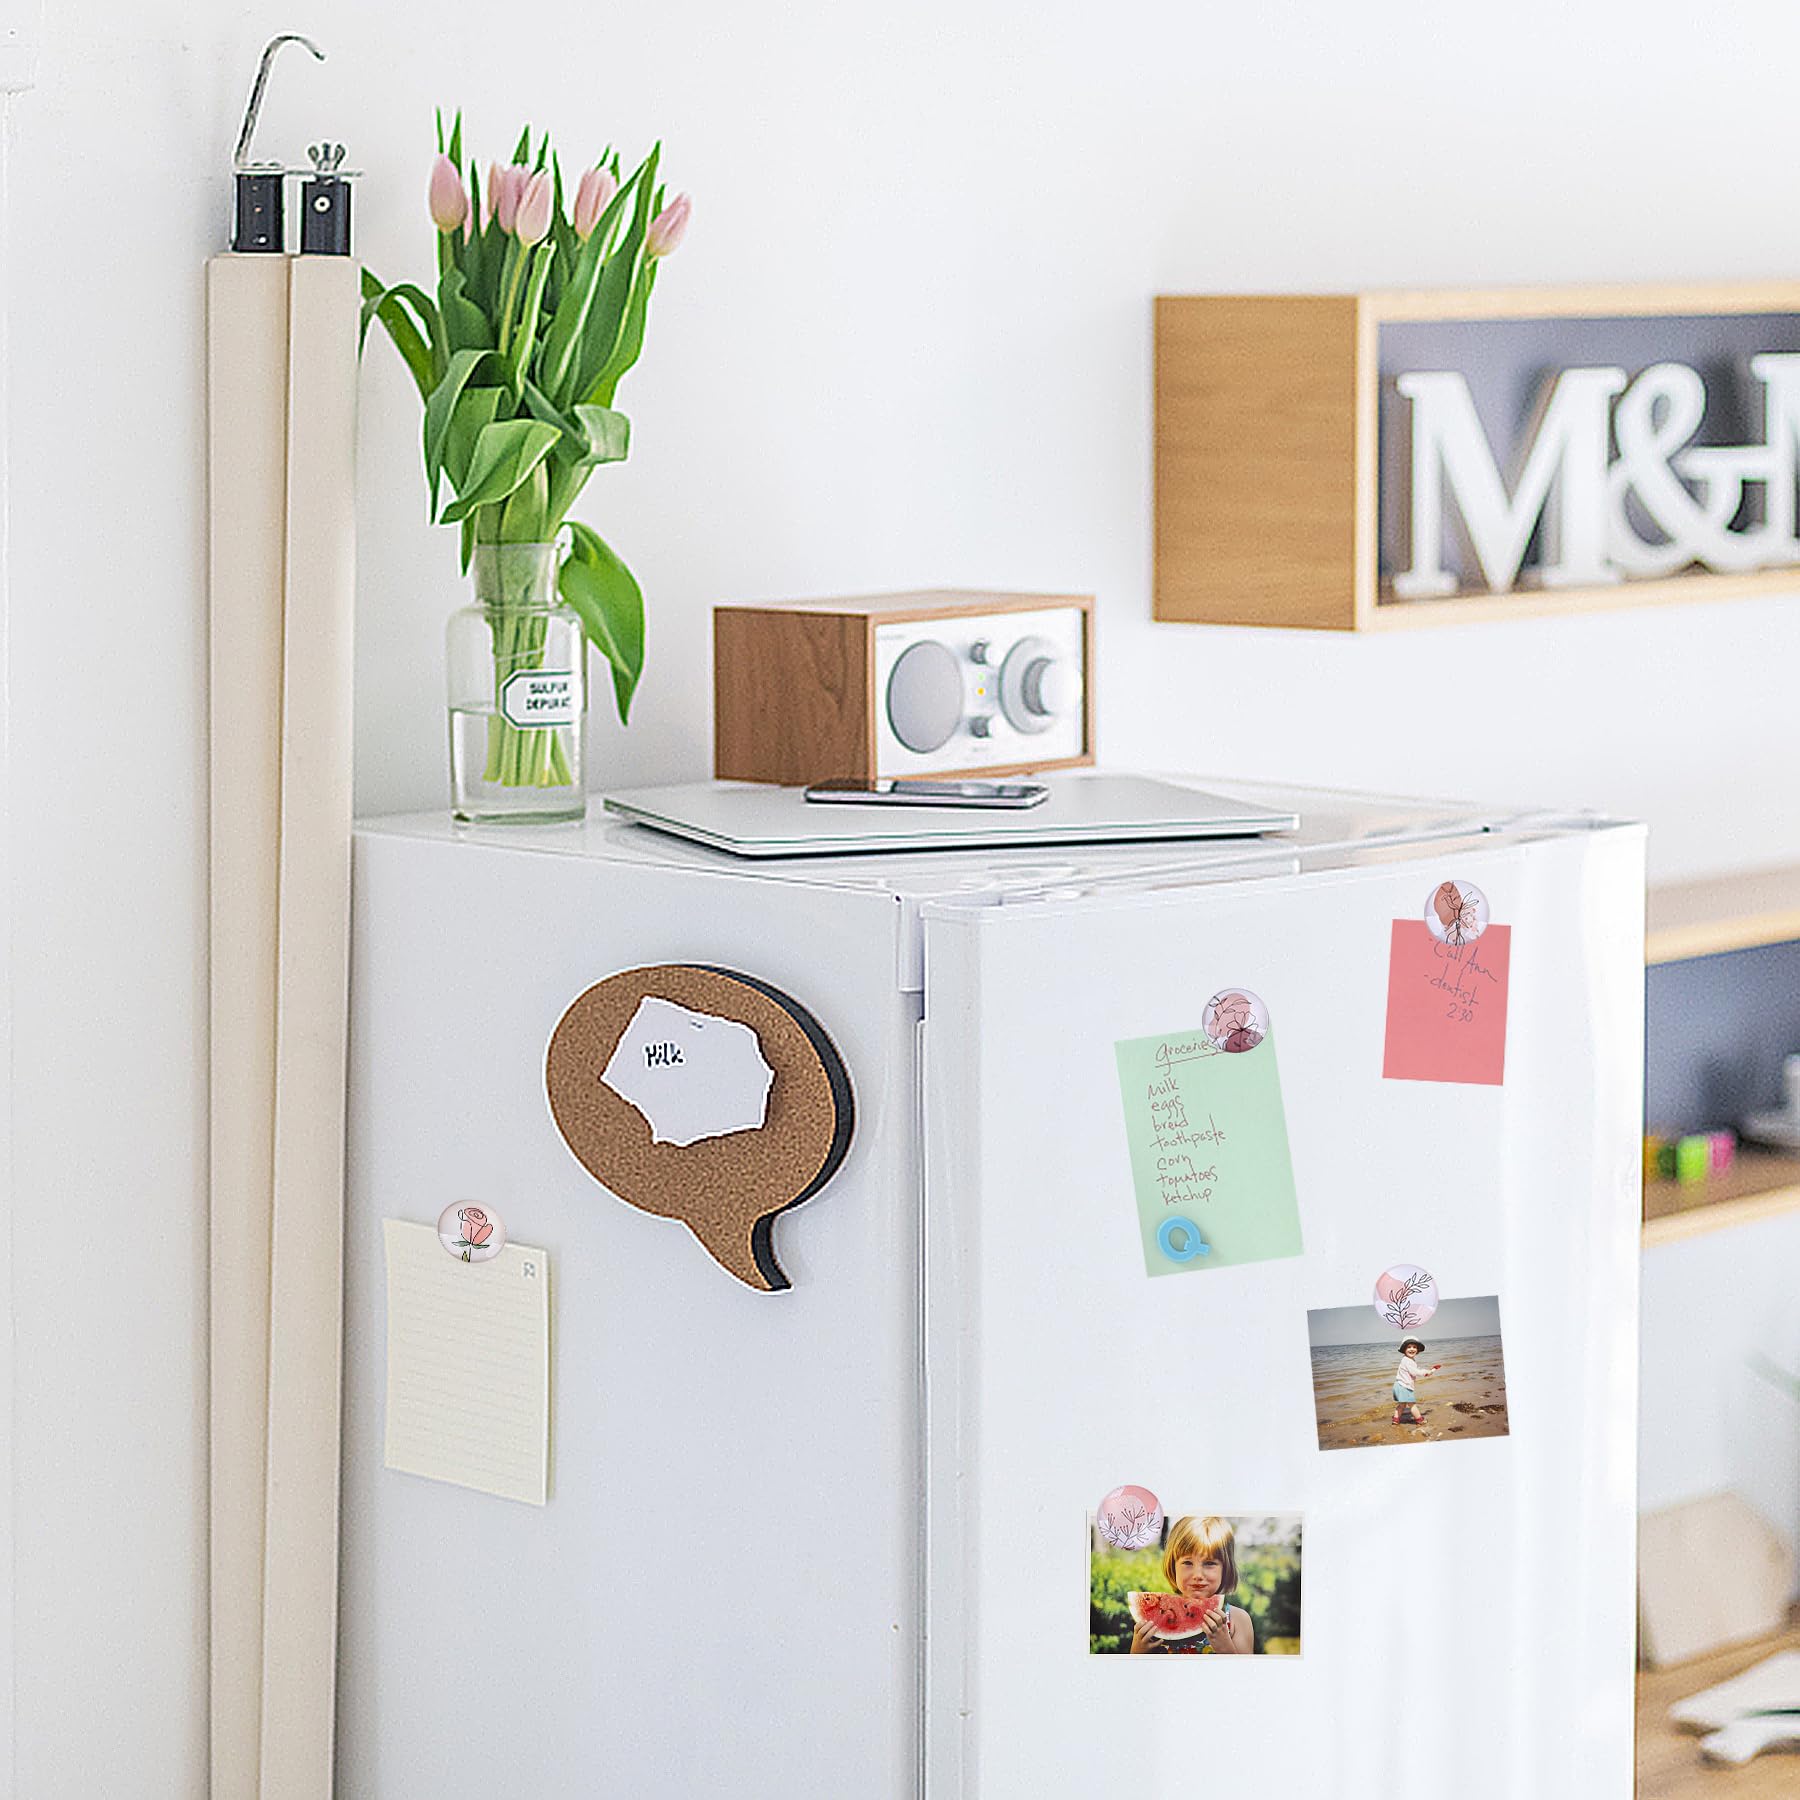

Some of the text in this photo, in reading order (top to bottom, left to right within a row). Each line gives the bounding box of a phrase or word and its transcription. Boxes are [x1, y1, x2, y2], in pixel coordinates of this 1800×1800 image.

[1393, 361, 1800, 594] M&
[1151, 1095, 1184, 1120] eggs
[1149, 1114, 1226, 1151] toothpaste
[1152, 1112, 1189, 1132] bread
[1156, 1165, 1218, 1188] tomatoes
[1162, 1185, 1212, 1206] ketchup
